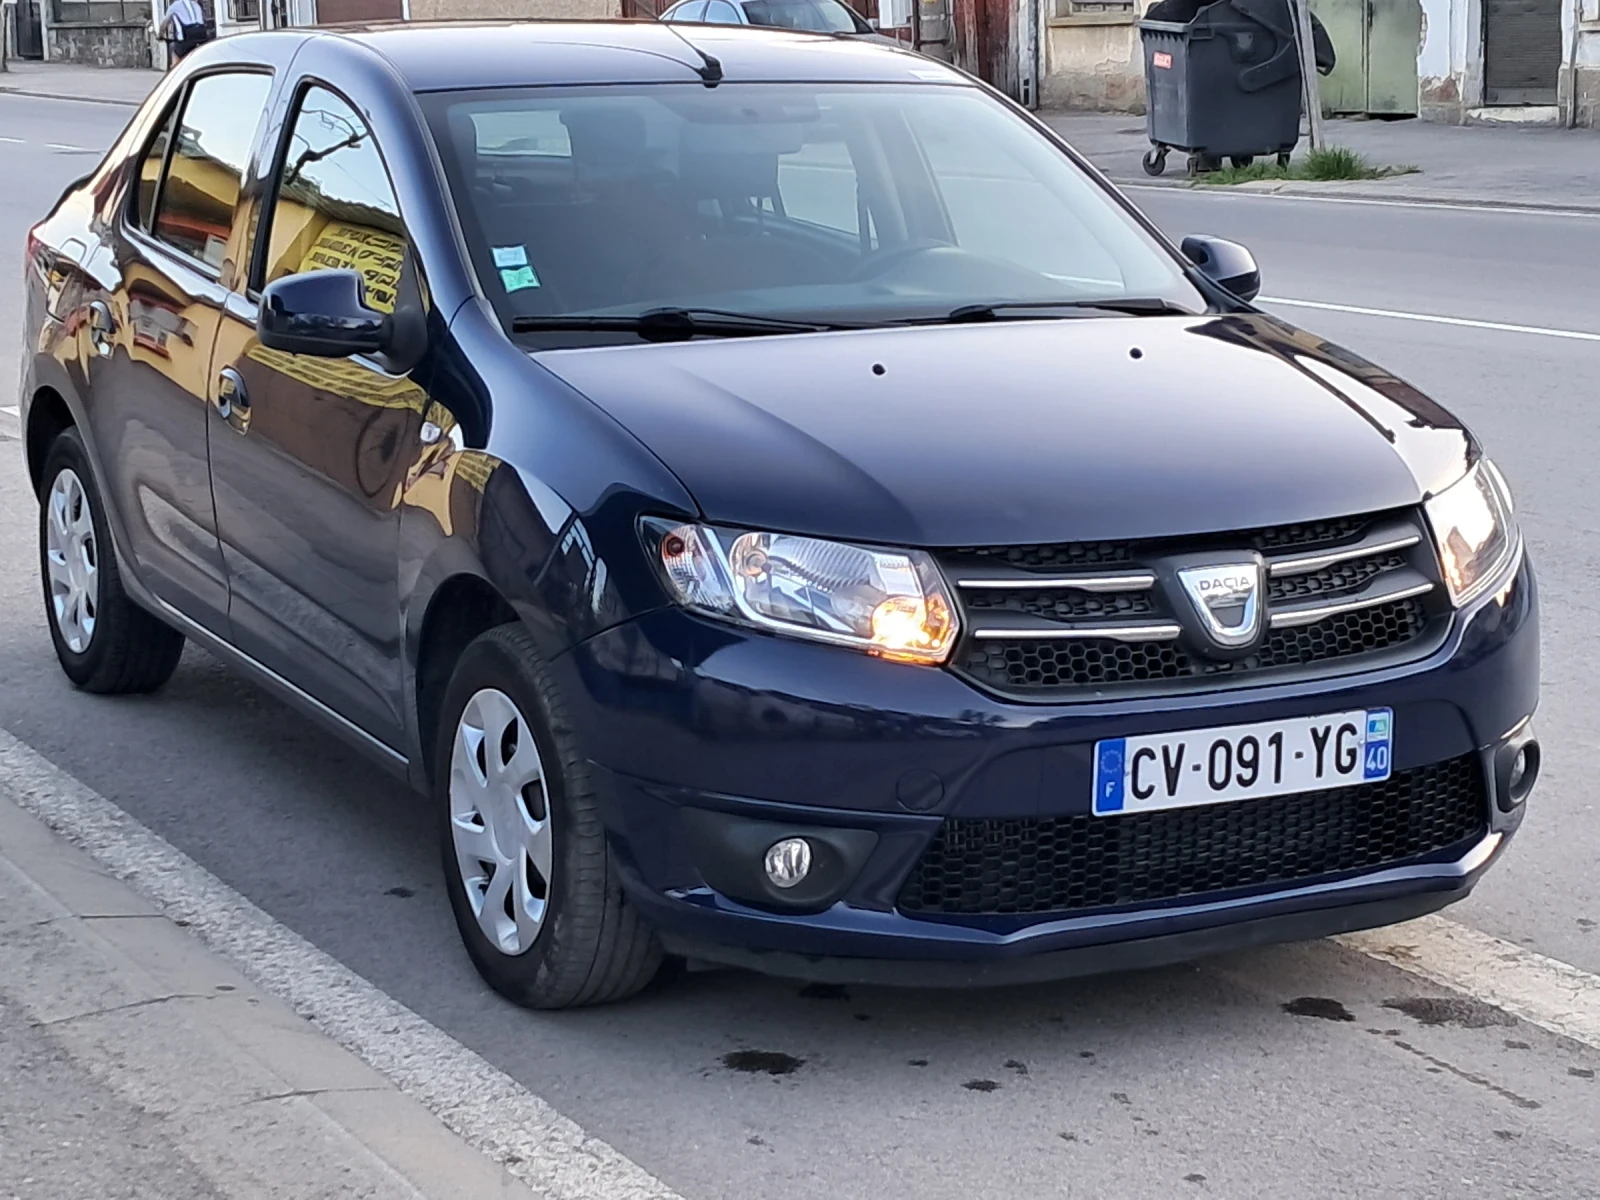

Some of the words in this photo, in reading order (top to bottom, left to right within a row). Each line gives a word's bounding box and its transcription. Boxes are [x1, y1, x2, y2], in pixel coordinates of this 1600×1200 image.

[1198, 576, 1250, 590] DACIA
[1105, 782, 1115, 798] F
[1131, 723, 1358, 800] CV-091-YG
[1365, 746, 1388, 771] 40
